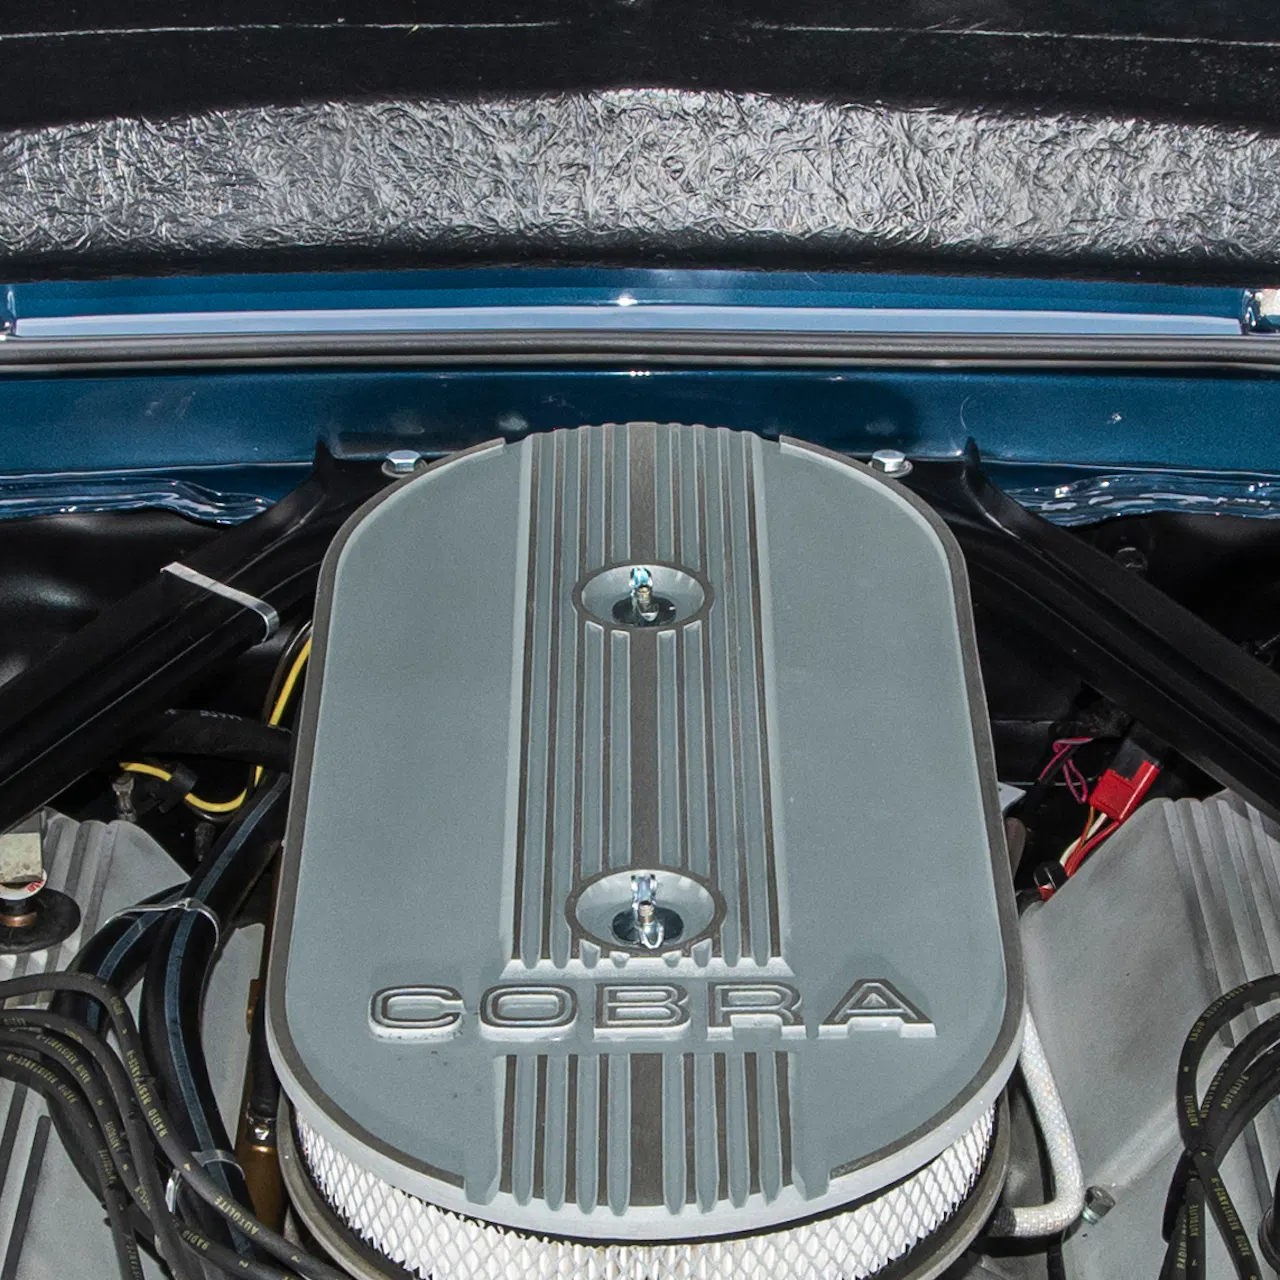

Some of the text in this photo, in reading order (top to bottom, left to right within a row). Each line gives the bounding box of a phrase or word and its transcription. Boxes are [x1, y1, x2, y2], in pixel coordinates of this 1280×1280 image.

[369, 979, 937, 1041] COBRA
[126, 1050, 152, 1109] RESISTANCE-H
[148, 1109, 168, 1137] RADIO
[215, 1195, 259, 1235] AUTOLITE
[182, 1229, 211, 1250] RADIO
